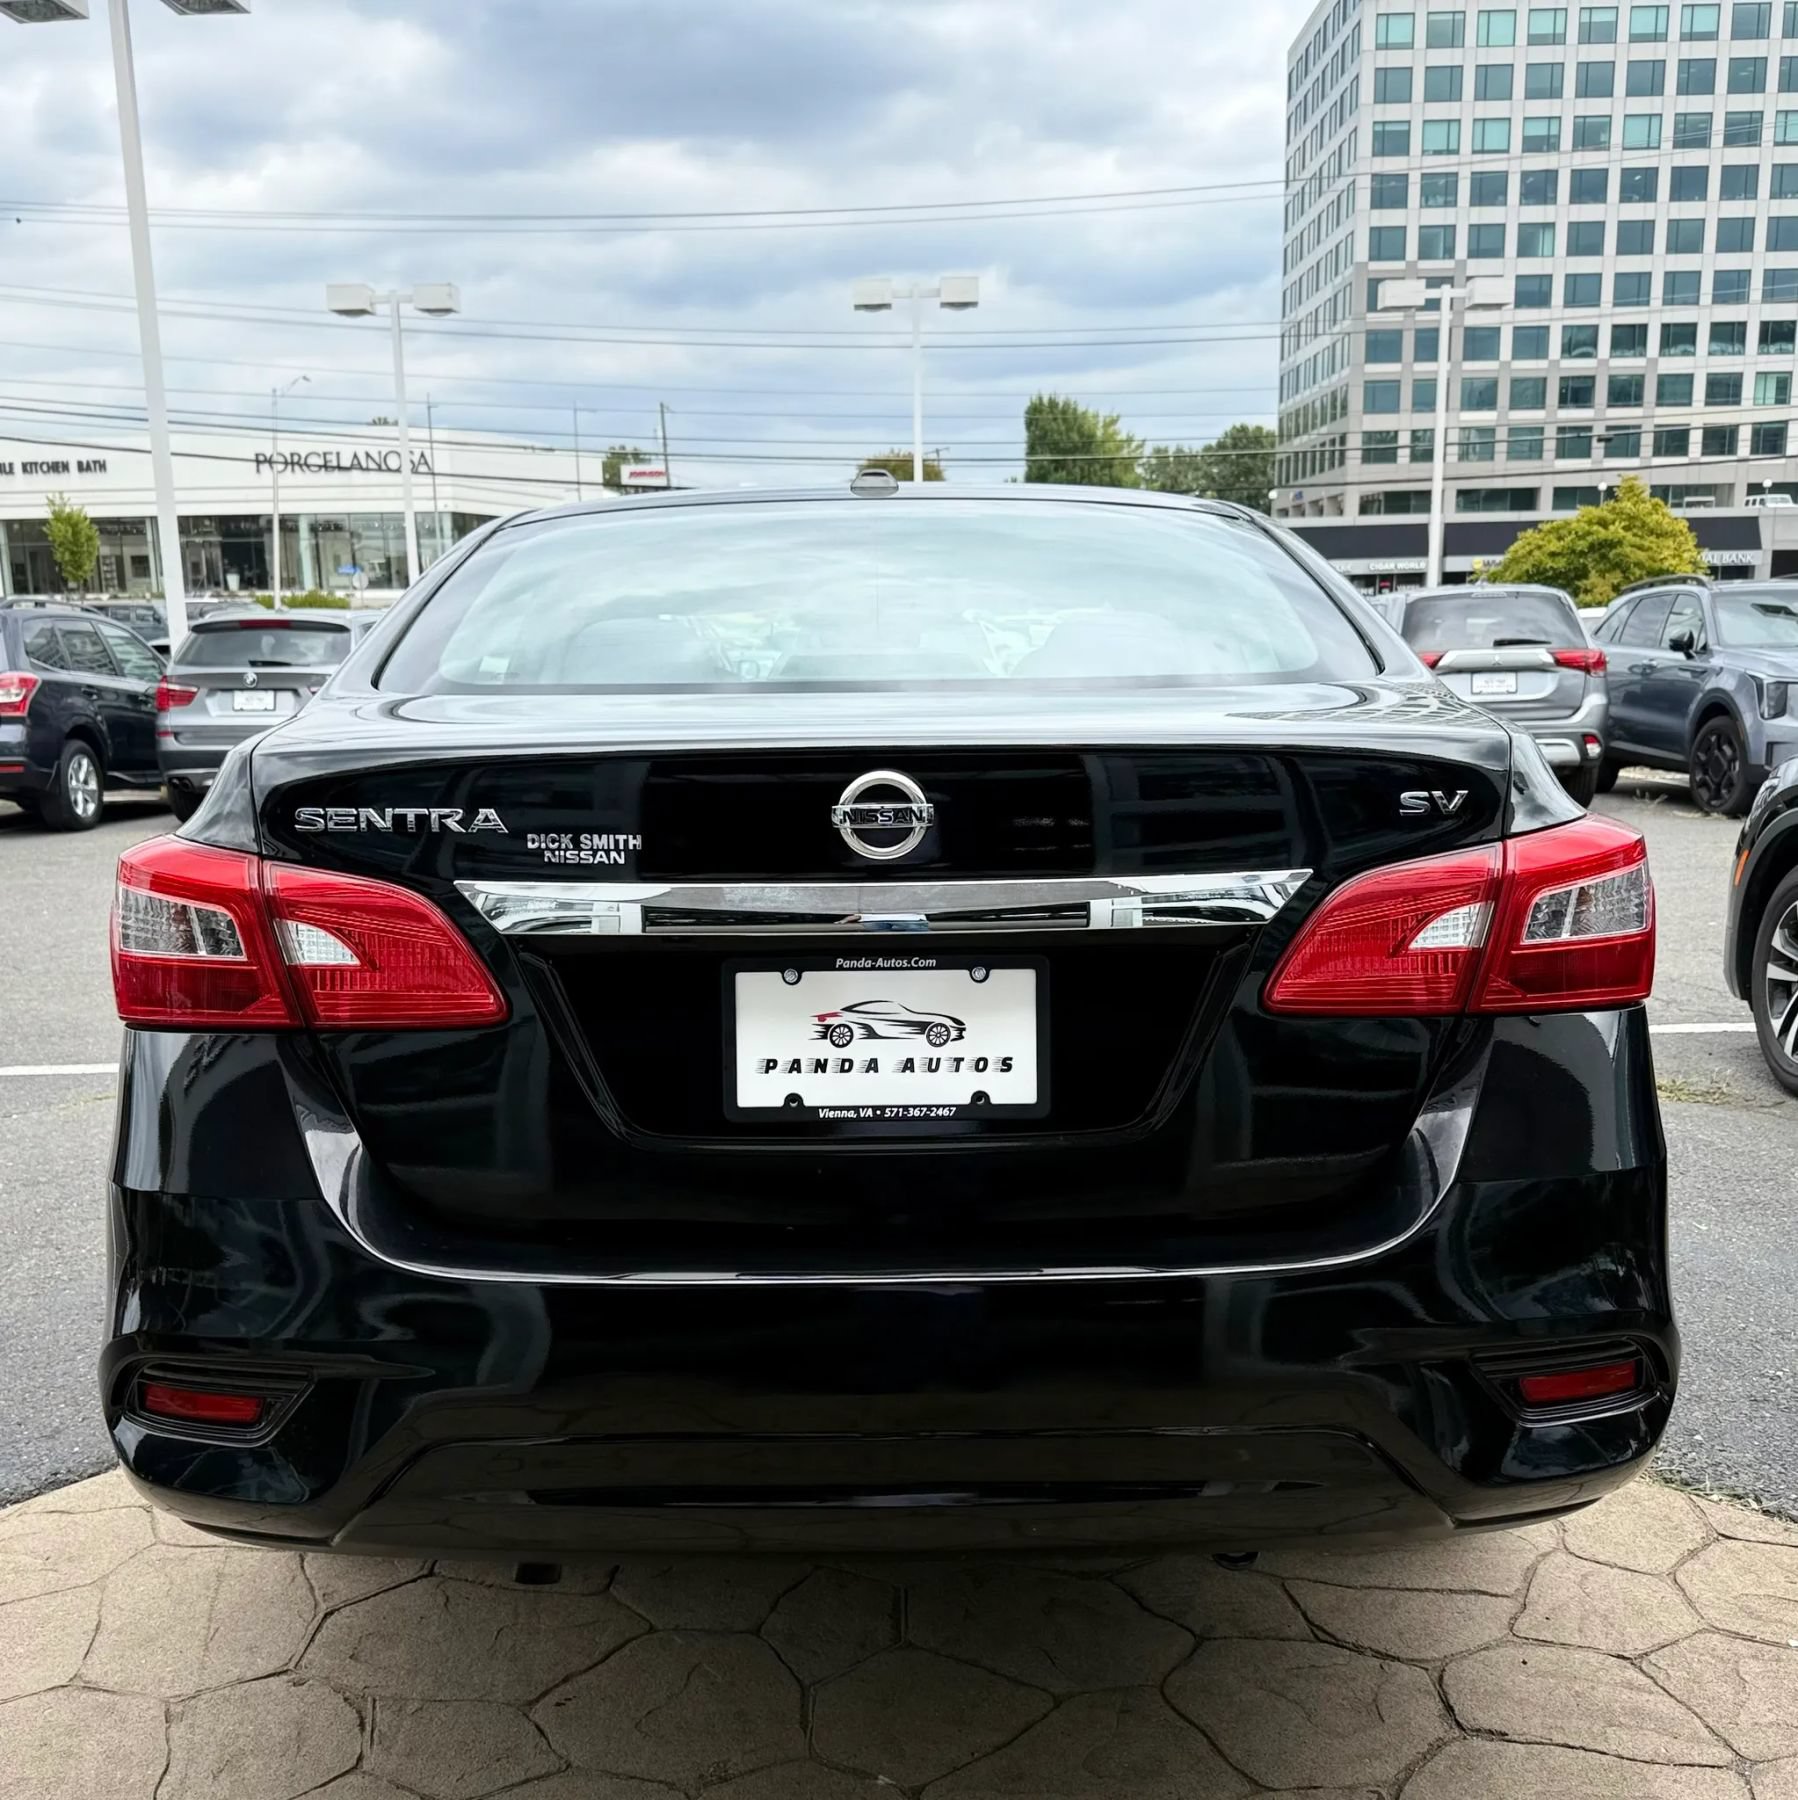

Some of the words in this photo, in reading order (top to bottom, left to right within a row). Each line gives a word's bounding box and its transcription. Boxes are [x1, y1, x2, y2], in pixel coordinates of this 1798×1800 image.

[21, 460, 70, 475] KITCHEN
[77, 459, 107, 473] BATH
[1399, 789, 1468, 816] SV
[295, 808, 508, 833] SENTRA
[842, 808, 925, 825] NISSAN
[527, 833, 574, 849] DICK
[580, 833, 642, 850] SMITH
[544, 850, 625, 865] NISSAN
[835, 956, 937, 969] Panda-Autos.Com
[757, 1057, 880, 1075] PANDA
[893, 1056, 1014, 1074] AUTOS
[818, 1107, 857, 1119] Vienna,
[859, 1107, 873, 1118] VA
[883, 1106, 957, 1118] 571-367-2467
